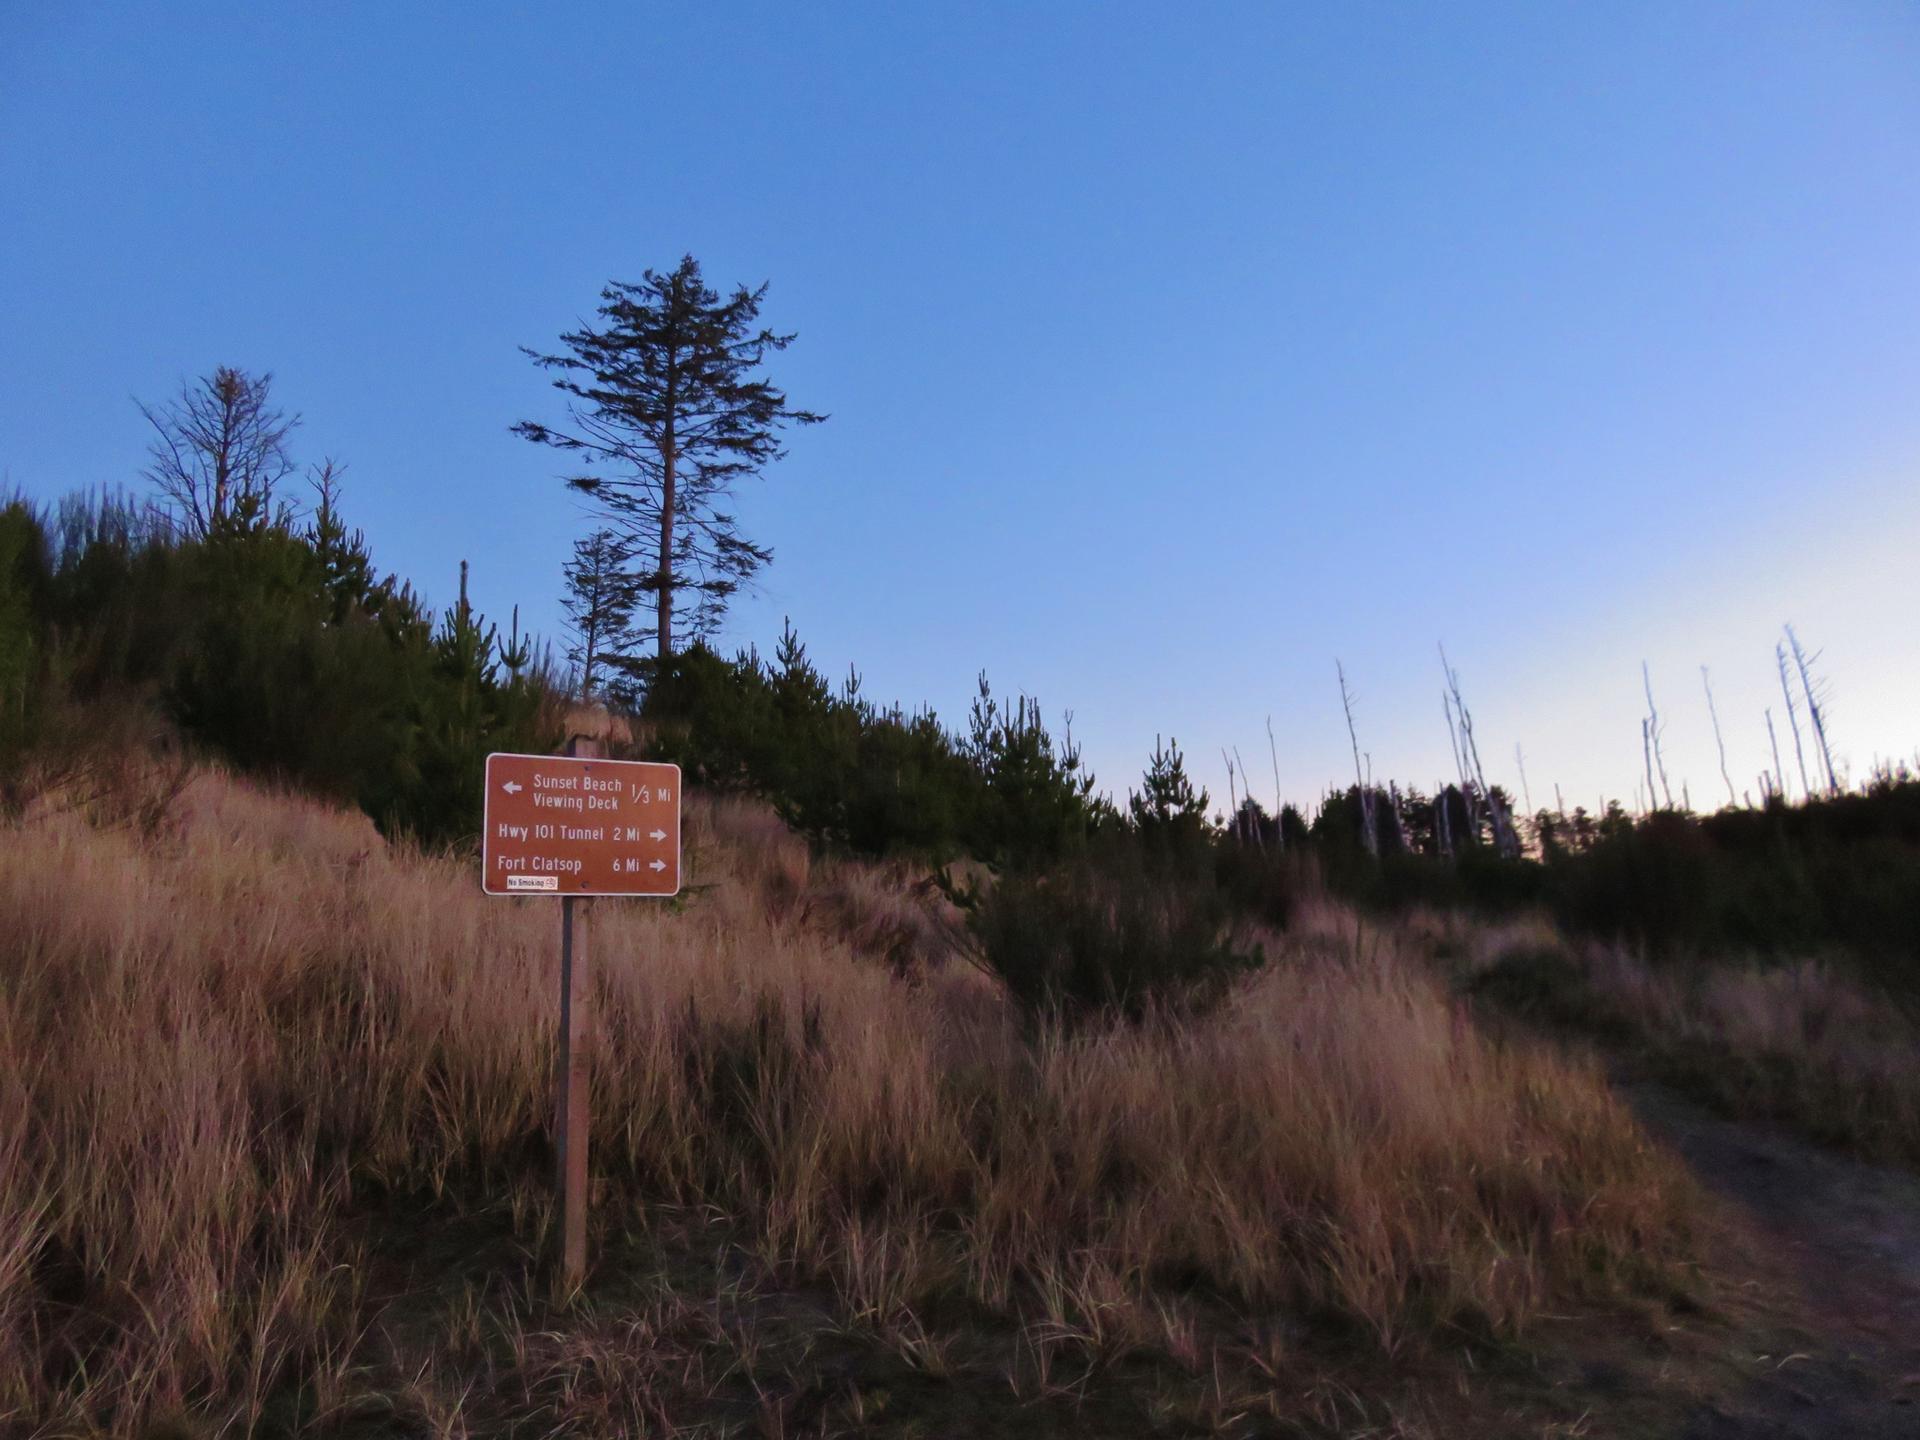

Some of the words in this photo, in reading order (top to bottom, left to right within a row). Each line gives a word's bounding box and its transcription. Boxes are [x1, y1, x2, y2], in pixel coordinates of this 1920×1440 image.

[533, 774, 577, 790] Sunset
[583, 777, 622, 792] Beach
[533, 793, 583, 812] Viewing
[588, 795, 619, 810] Deck
[632, 784, 650, 804] 1/3
[658, 788, 671, 802] Mi
[498, 823, 528, 842] Hwy
[535, 825, 554, 839] 101
[560, 825, 604, 841] Tunnel
[613, 827, 621, 841] 2
[627, 827, 640, 841] Mi
[498, 856, 526, 871] Fort
[532, 857, 582, 875] Clatsop
[613, 859, 621, 872] 6
[626, 859, 640, 872] Mi
[518, 879, 545, 888] Smoking
